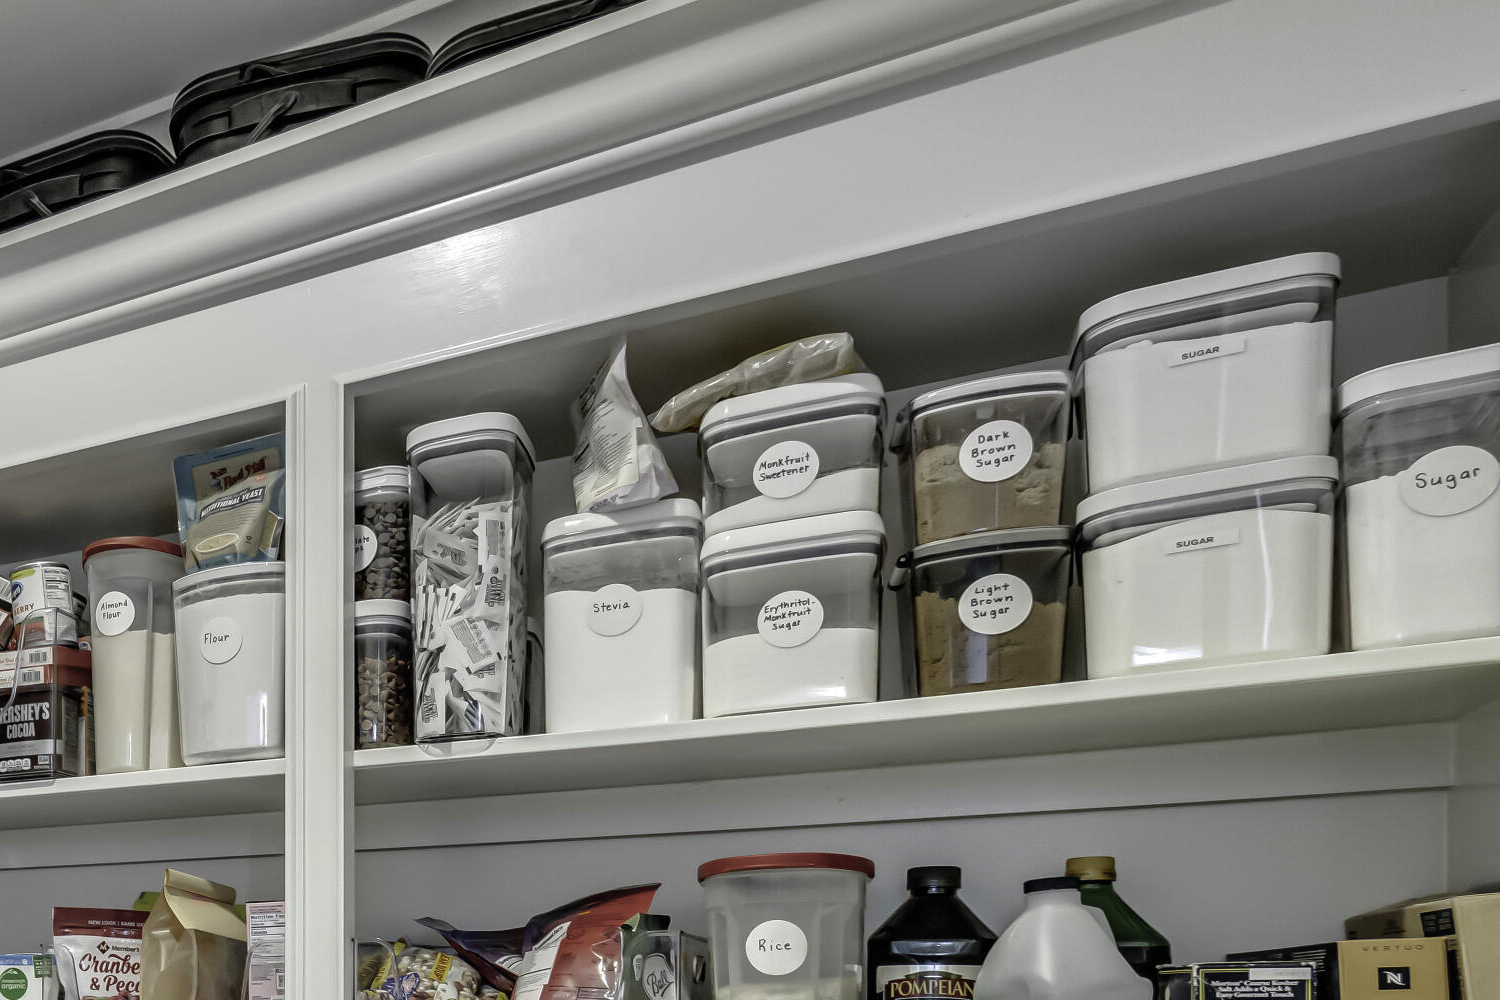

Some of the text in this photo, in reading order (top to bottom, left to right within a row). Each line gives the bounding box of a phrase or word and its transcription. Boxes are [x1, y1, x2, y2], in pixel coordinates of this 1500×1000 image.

[1181, 346, 1220, 360] SUGAR
[977, 431, 1010, 444] Dark
[972, 445, 1016, 458] Brown
[759, 453, 810, 471] Monkfruit
[976, 453, 1015, 469] Sugar
[758, 465, 810, 482] Sweetener
[1415, 465, 1481, 491] Sugar
[1175, 536, 1214, 548] SUGAR
[974, 582, 1010, 595] Light
[101, 600, 128, 613] Almond
[593, 601, 630, 613] Stevia
[970, 595, 1013, 607] Brown
[102, 611, 122, 620] Flour
[763, 608, 812, 623] Monkfruit
[972, 607, 1010, 620] Sugar
[772, 619, 801, 631] Sugar
[204, 631, 231, 645] Flour
[7, 722, 36, 739] COCOA
[758, 938, 792, 953] Rice
[1361, 944, 1424, 952] VERTUO
[89, 980, 100, 991] &
[647, 972, 675, 998] Ball
[890, 979, 975, 998] POMPEIAN
